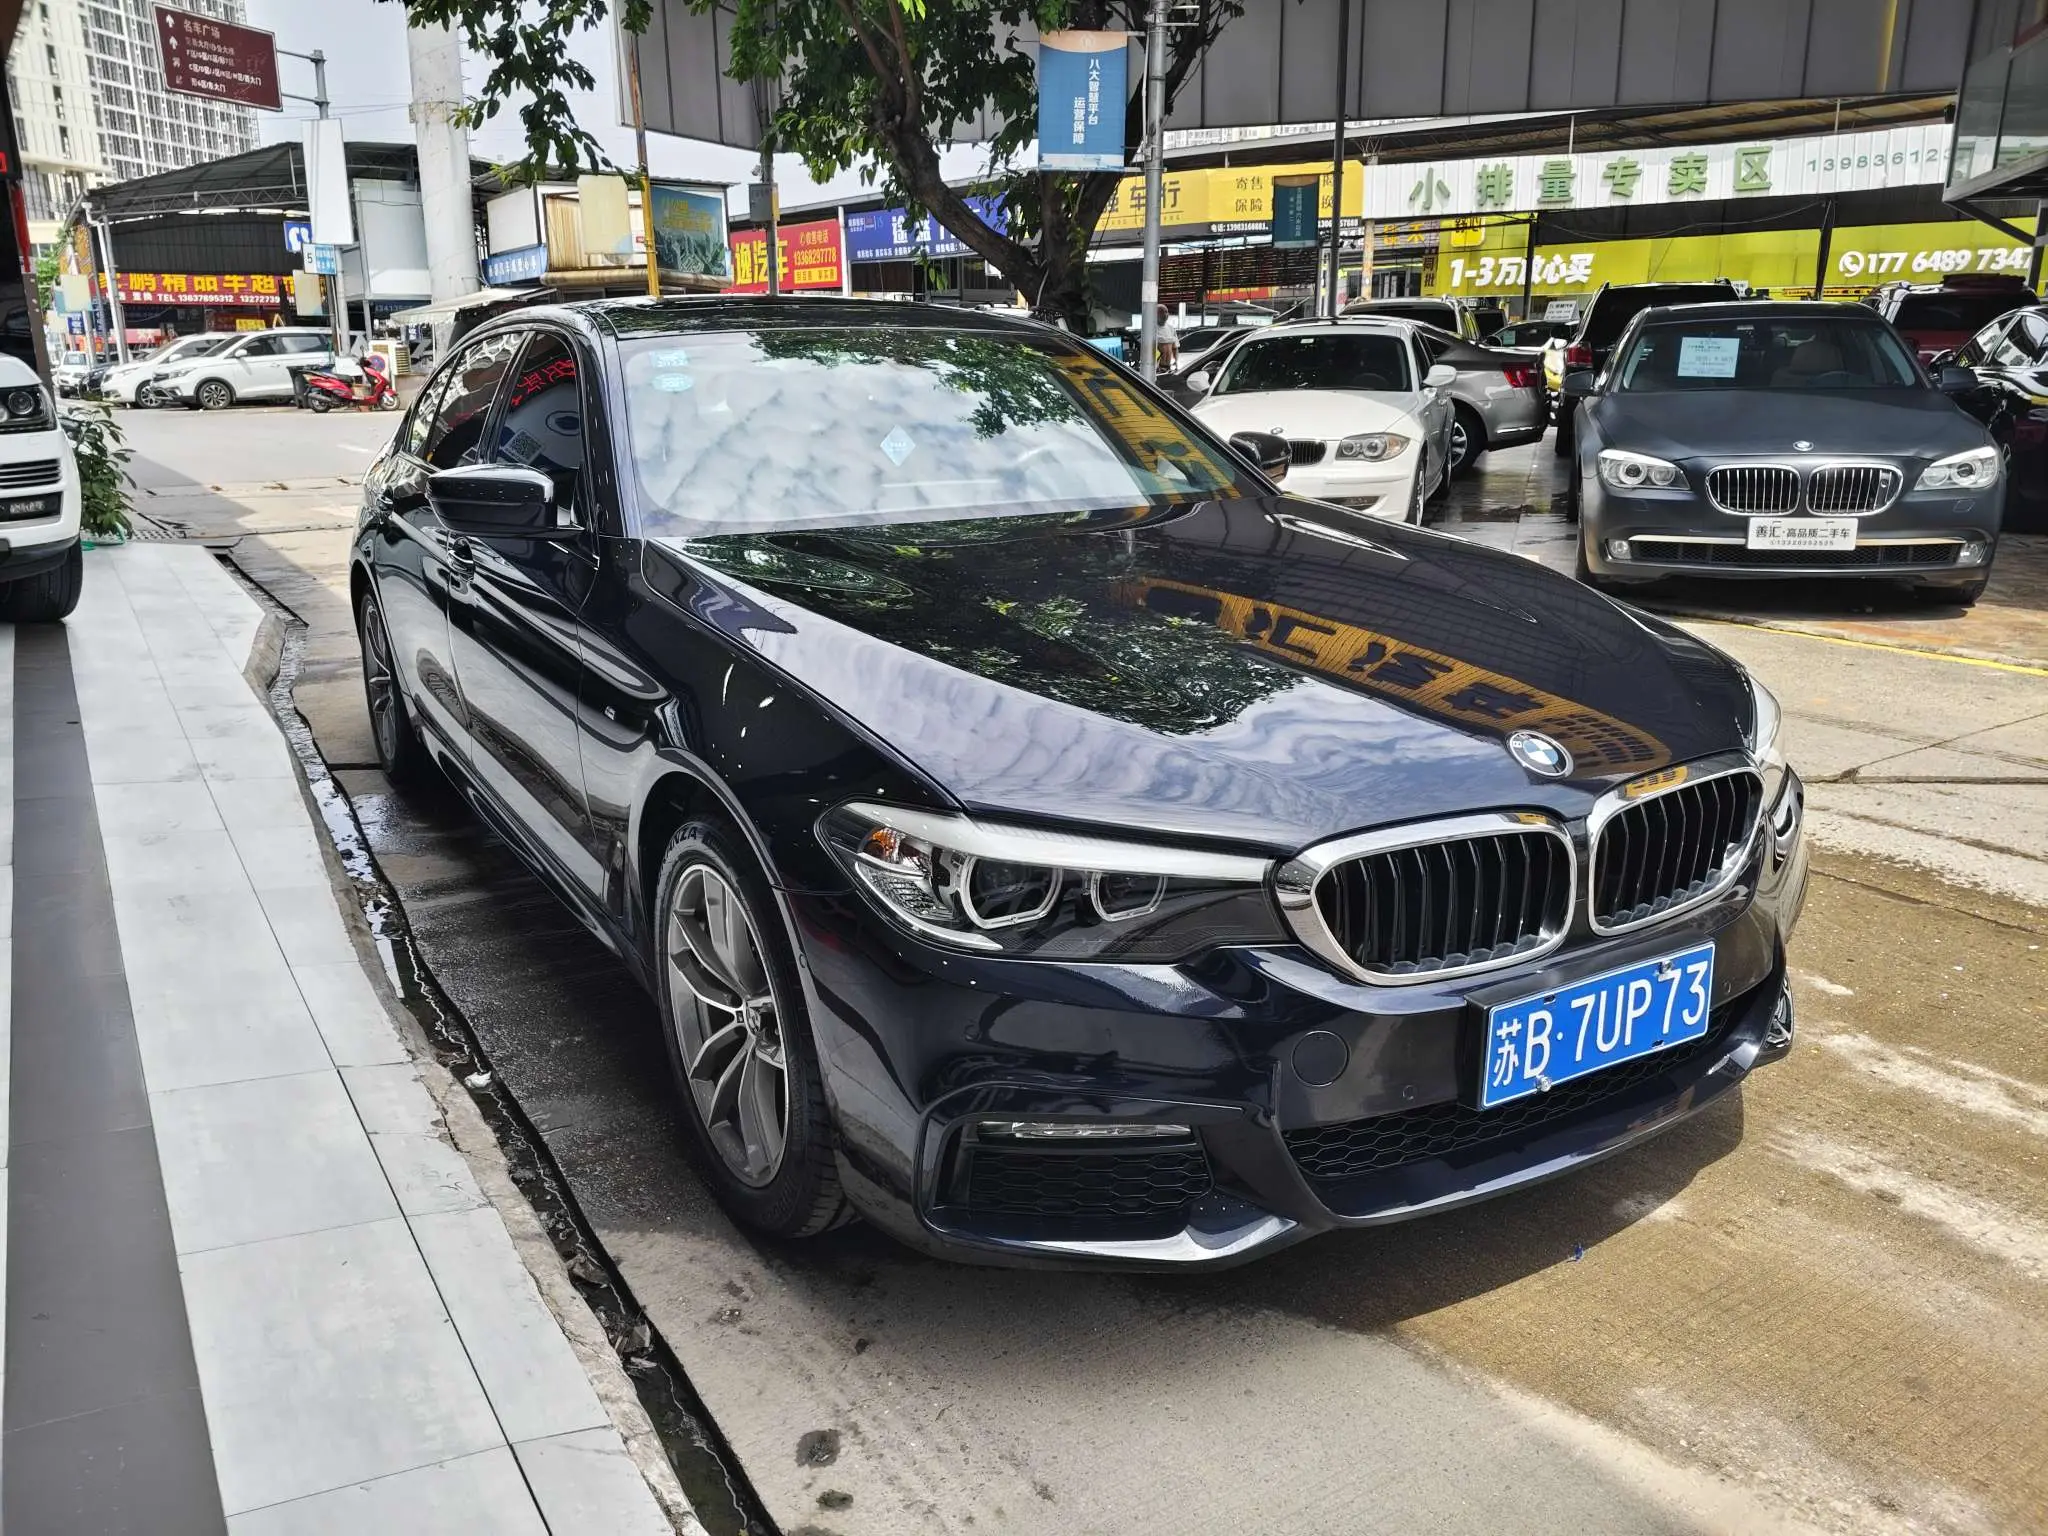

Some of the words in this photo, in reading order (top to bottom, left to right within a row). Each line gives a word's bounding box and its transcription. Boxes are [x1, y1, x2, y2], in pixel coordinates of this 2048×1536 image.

[184, 19, 220, 39] 名车广场
[1088, 59, 1100, 125] 八大智慧平台
[1073, 97, 1085, 145] 运营保障
[1236, 176, 1263, 191] 寄售
[1409, 146, 1773, 210] 小排量专卖区
[1235, 198, 1263, 212] 保险
[1868, 251, 1907, 273] 177
[1912, 249, 1971, 272] 6489
[1977, 248, 2033, 271] 7347
[158, 294, 175, 302] TEL
[1493, 960, 1709, 1087] 苏B·7UP73
